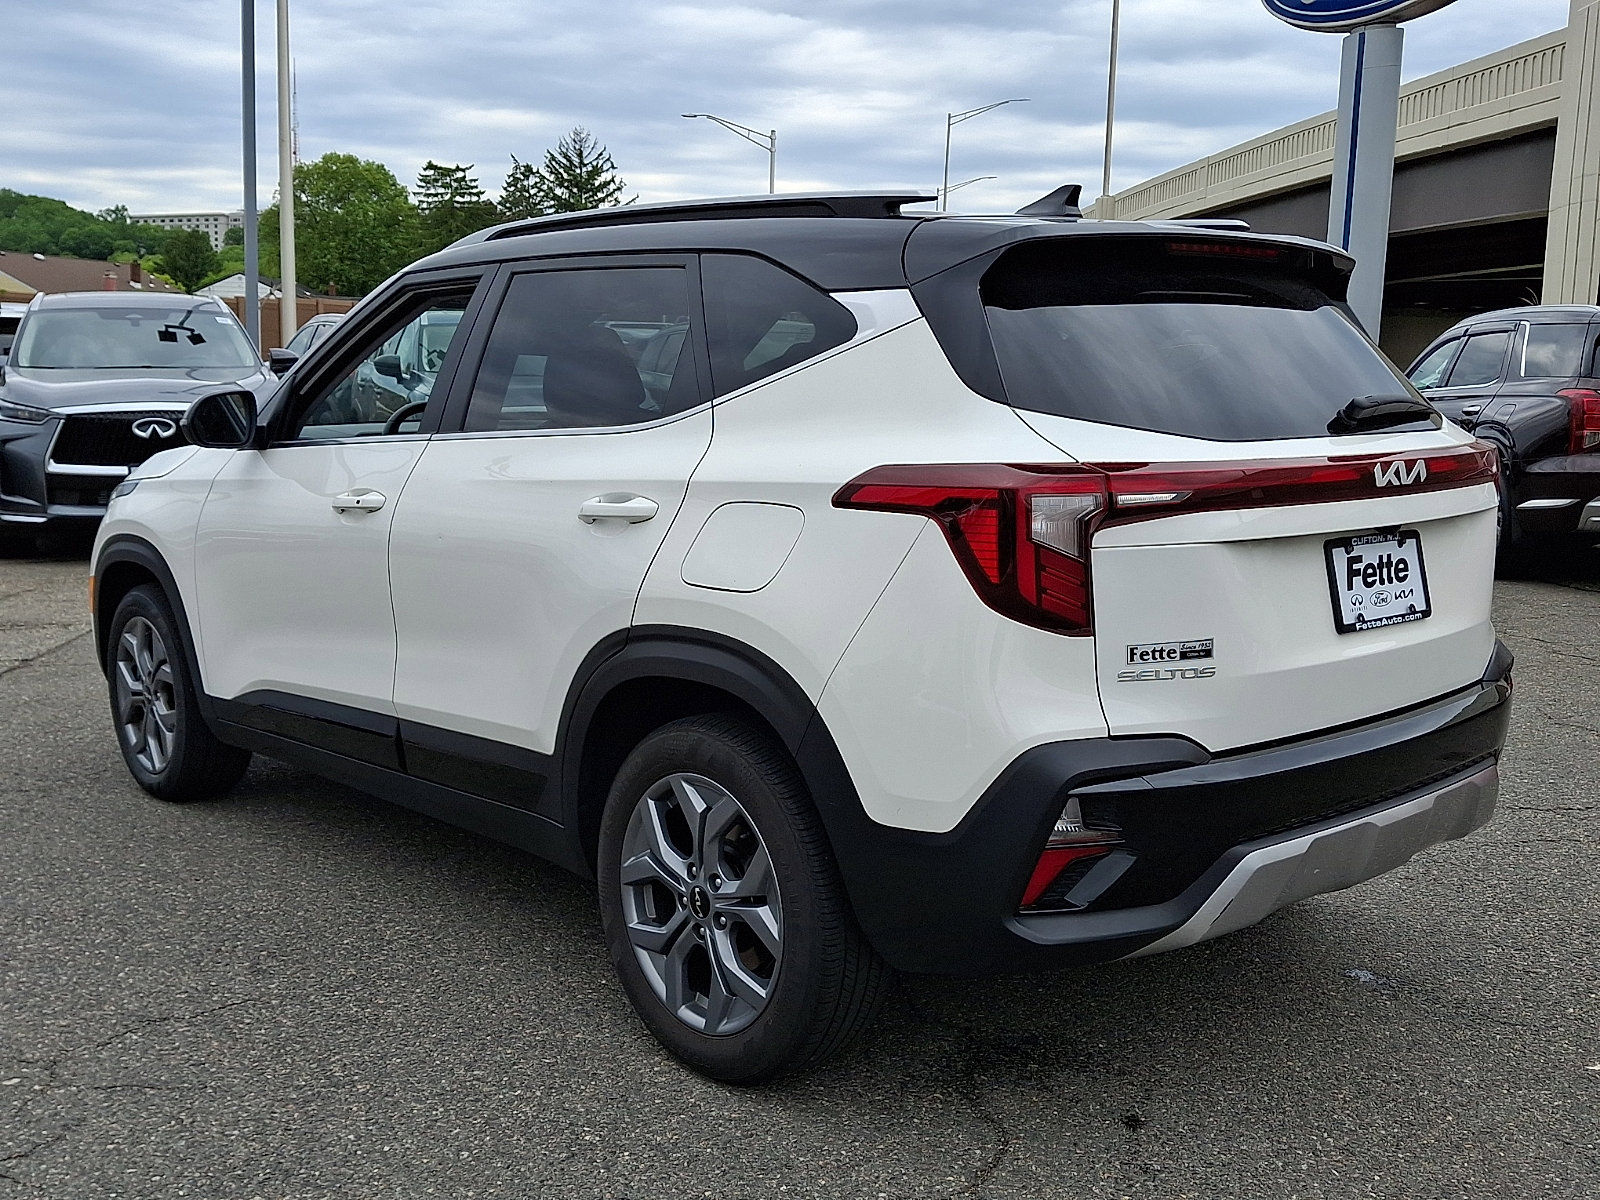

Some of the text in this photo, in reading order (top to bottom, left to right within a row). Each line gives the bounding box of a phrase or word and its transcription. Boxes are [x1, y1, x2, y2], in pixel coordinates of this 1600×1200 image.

[1374, 459, 1427, 487] KIA
[1347, 553, 1409, 591] Fette
[1356, 613, 1422, 631] FetteAuto.com
[1129, 646, 1177, 662] Fette
[1117, 666, 1216, 682] SELTOS
